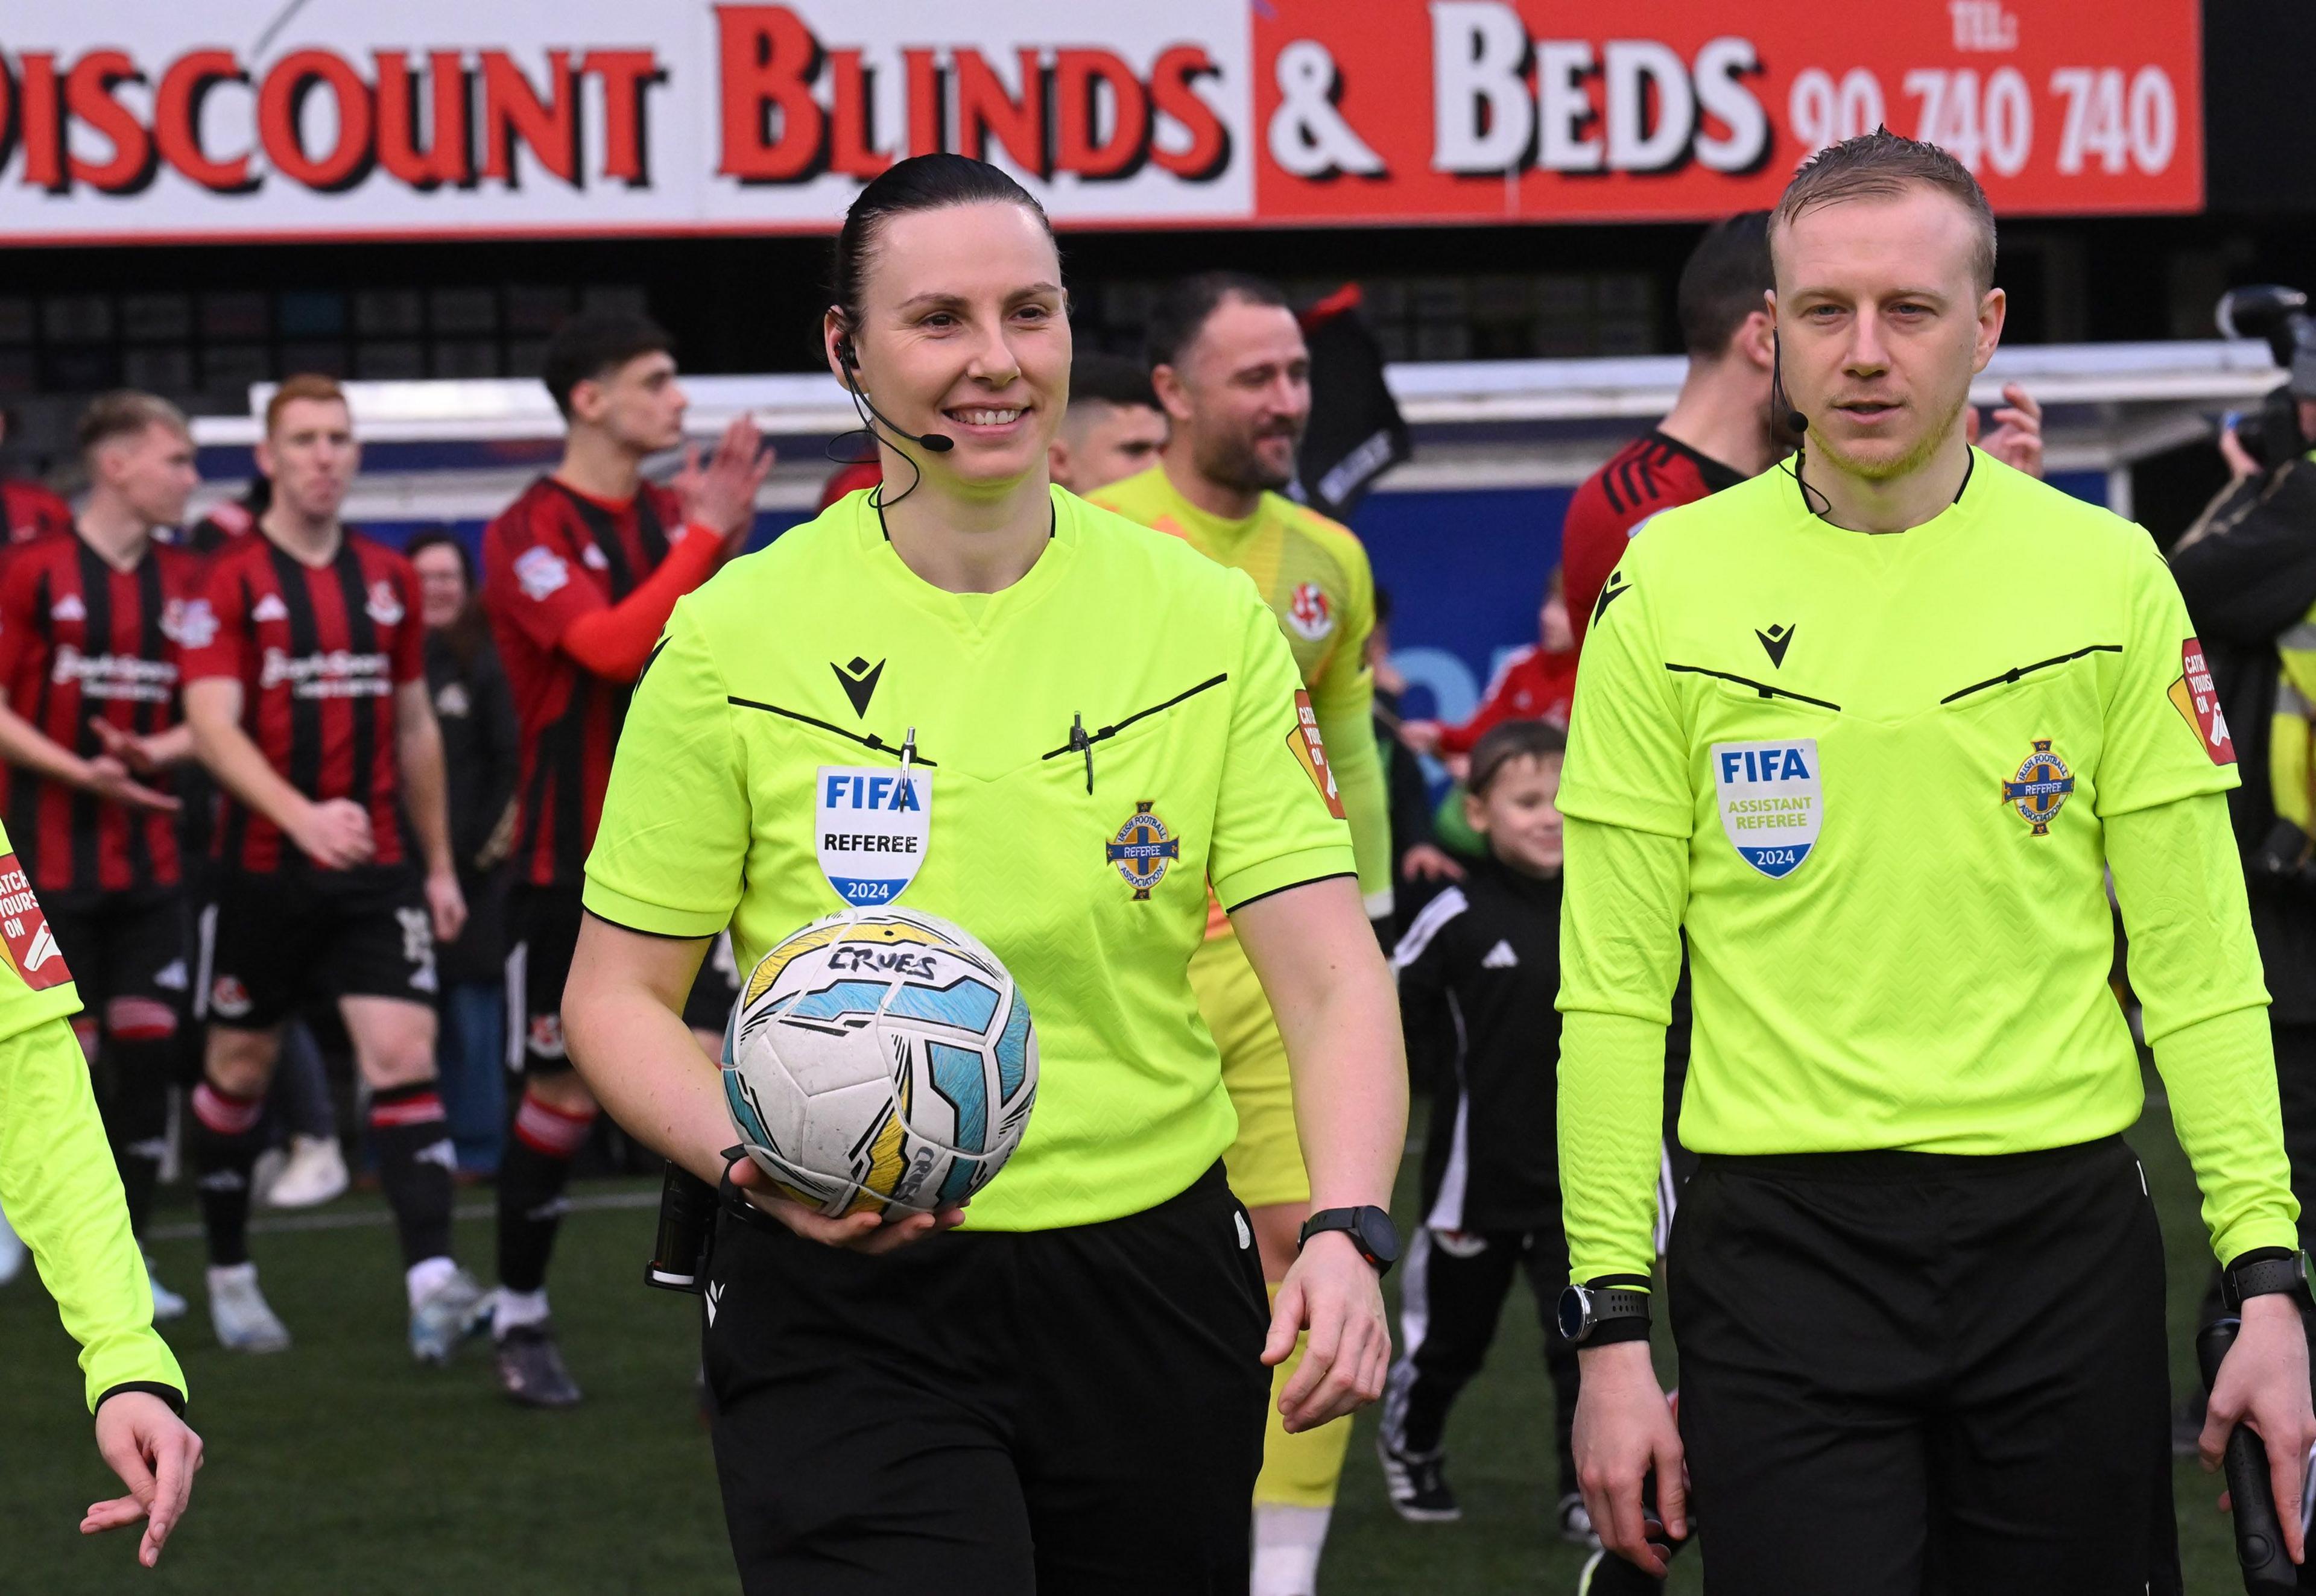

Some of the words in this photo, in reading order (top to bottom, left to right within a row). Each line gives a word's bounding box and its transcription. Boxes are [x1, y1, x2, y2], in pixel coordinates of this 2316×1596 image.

[0, 45, 668, 196] ISCOUNT
[714, 3, 1230, 184] BLINDS
[1268, 39, 1386, 180] &
[1428, 1, 1772, 180] BEDS
[1903, 66, 2033, 177] 740
[2050, 65, 2177, 175] 740
[2196, 696, 2210, 714] ON
[1721, 748, 1811, 783] FIFA
[2018, 760, 2034, 781] IRISH
[2034, 754, 2068, 777] FOOTBALL
[826, 775, 920, 811] FIFA
[2025, 782, 2062, 795] REFEREE
[1728, 796, 1812, 813] ASSISTANT
[2019, 802, 2062, 822] ASSOCIATION
[1118, 821, 1133, 842] IRISH
[1134, 815, 1166, 840] FOOTBALL
[1736, 813, 1808, 830] REFEREE
[824, 833, 917, 853] REFEREE
[1124, 845, 1161, 858] REFEREE
[1756, 850, 1796, 865] 2024
[0, 870, 30, 896] ATCH
[1121, 866, 1163, 887] ASSOCIATION
[847, 882, 889, 898] 2024
[4, 917, 25, 938] ON
[827, 946, 937, 980] CRUES
